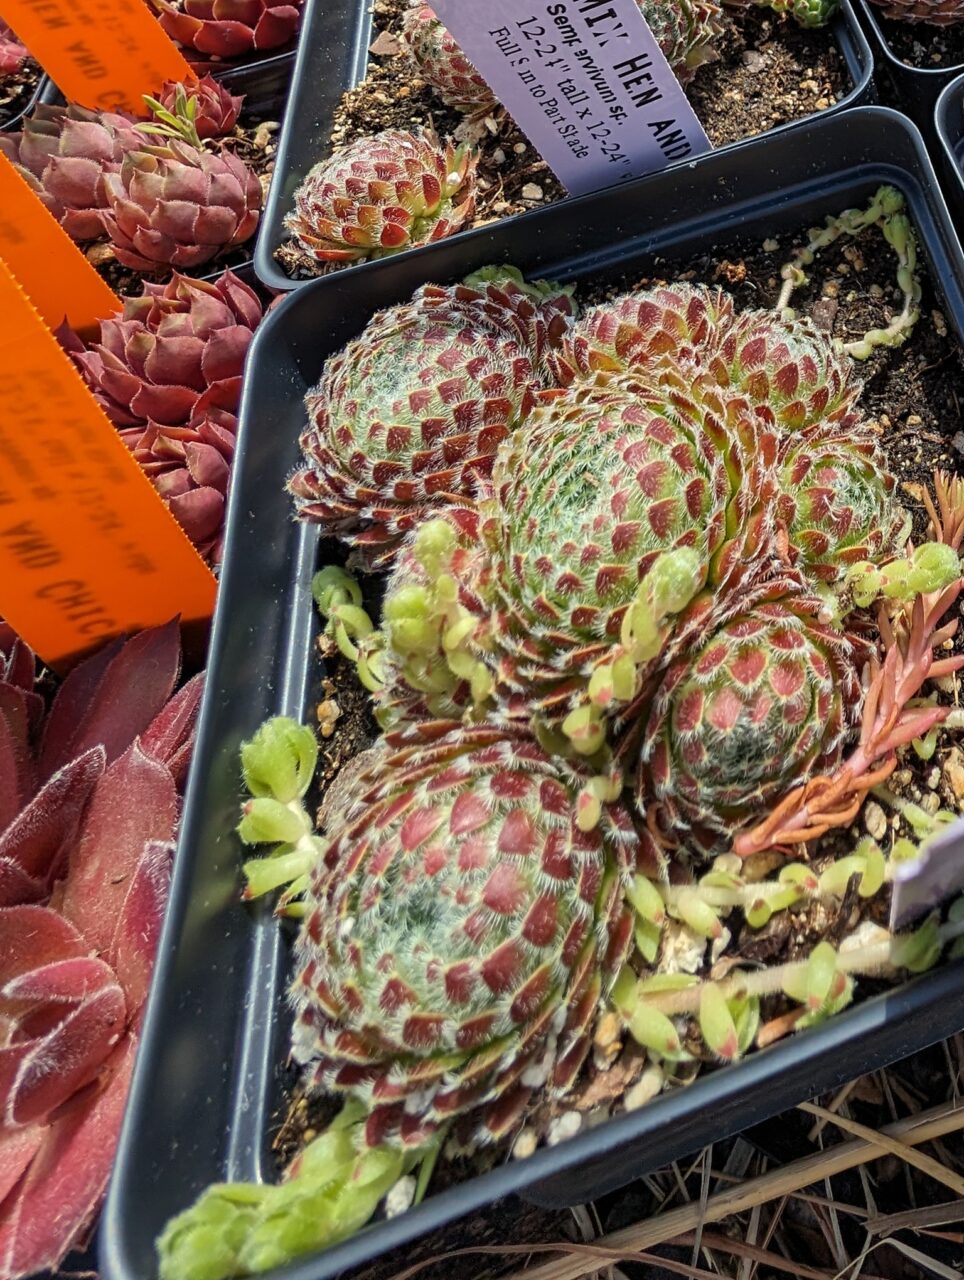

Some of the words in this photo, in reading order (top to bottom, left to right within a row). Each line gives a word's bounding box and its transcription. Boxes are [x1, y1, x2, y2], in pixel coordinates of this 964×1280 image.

[488, 26, 522, 57] Full
[529, 84, 546, 98] to
[539, 97, 567, 125] Part
[557, 78, 590, 106] tall
[576, 107, 592, 120] x
[613, 53, 663, 108] HEN
